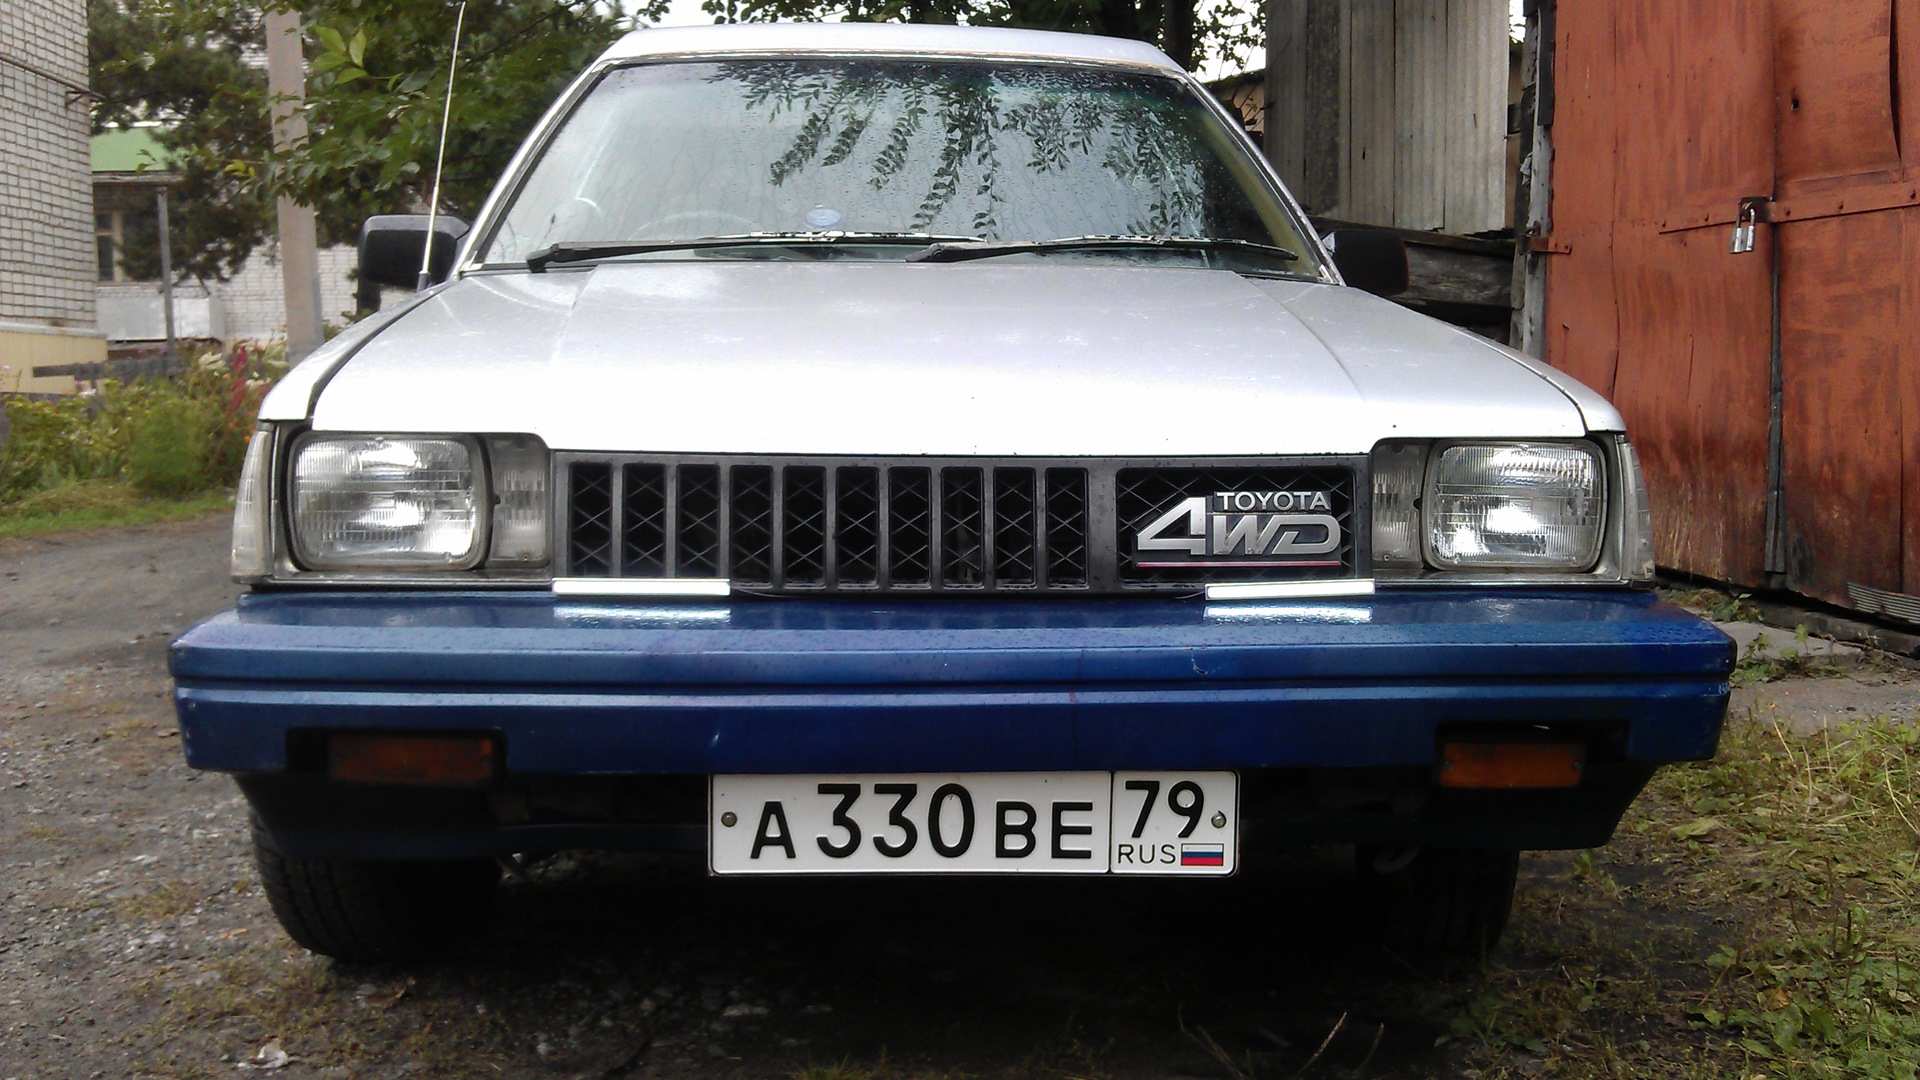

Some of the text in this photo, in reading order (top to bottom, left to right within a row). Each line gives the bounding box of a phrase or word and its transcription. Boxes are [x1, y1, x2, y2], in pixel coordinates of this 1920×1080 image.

[1137, 497, 1341, 555] 4WD
[1216, 491, 1331, 511] TOYOTA
[750, 783, 1093, 859] A330BE
[1124, 780, 1205, 838] 79
[1117, 844, 1176, 864] RUS
